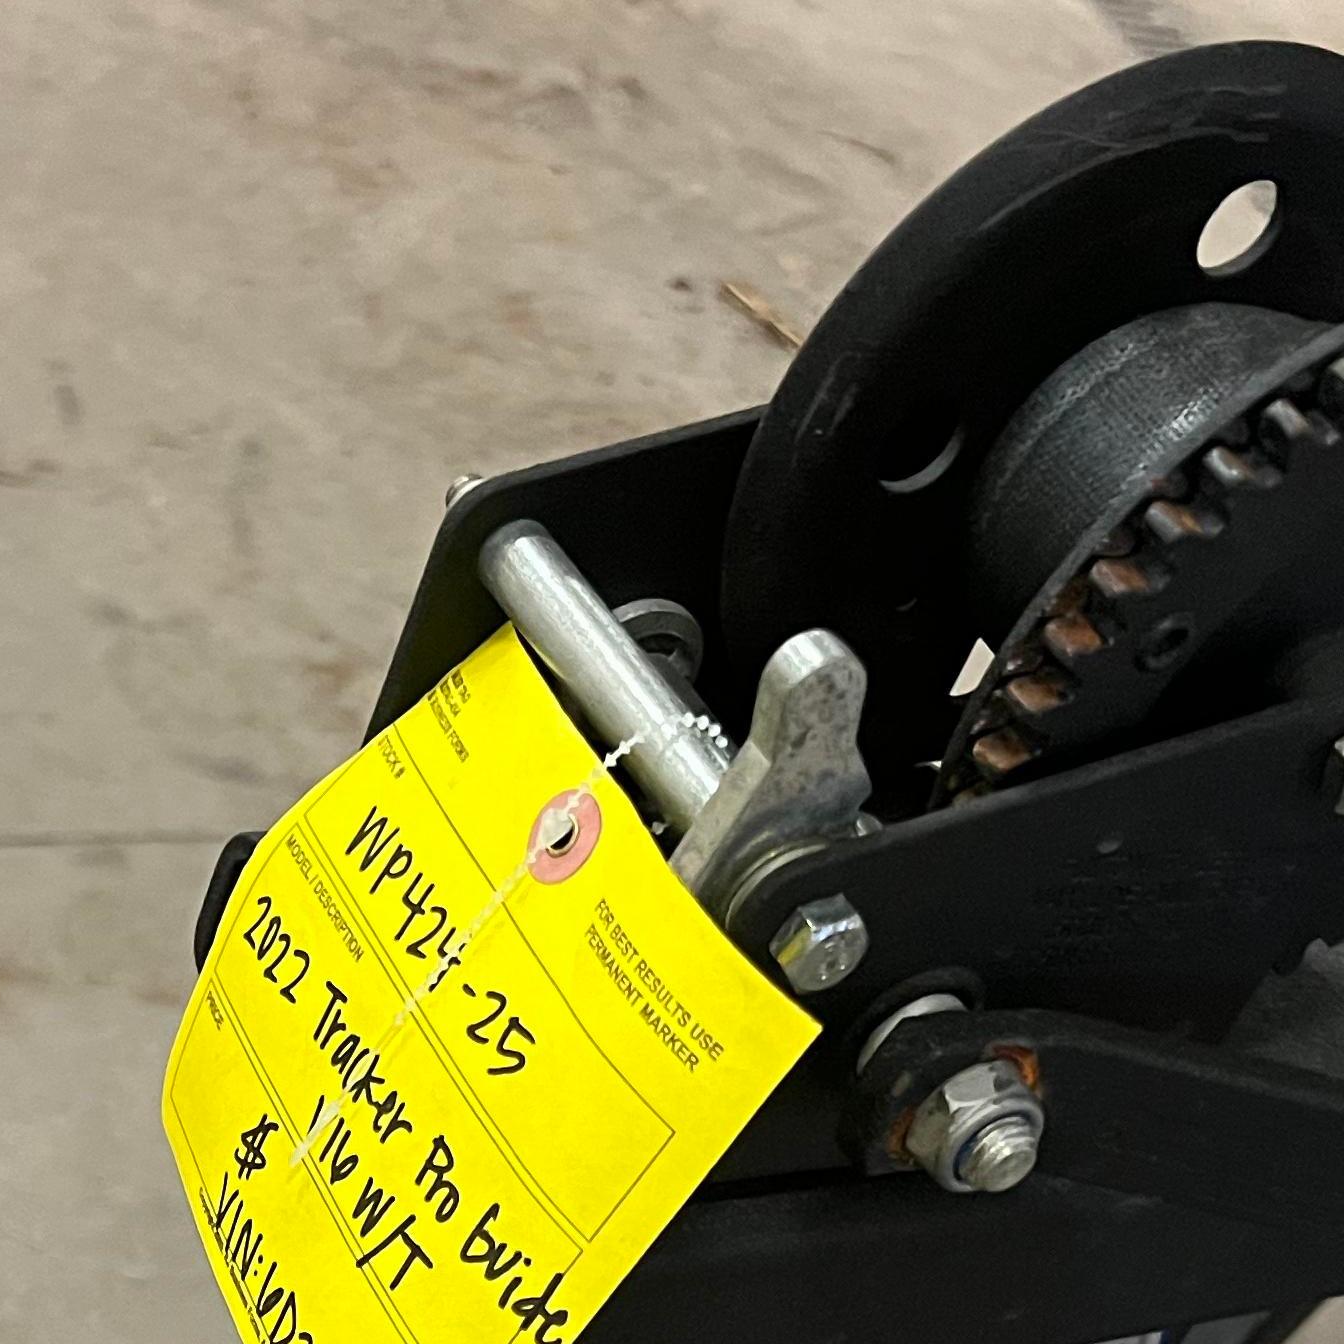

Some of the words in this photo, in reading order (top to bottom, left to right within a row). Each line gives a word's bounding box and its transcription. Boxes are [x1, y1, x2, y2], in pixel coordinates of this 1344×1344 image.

[285, 834, 313, 885] MODEL
[313, 880, 365, 963] DESCRIPTION
[584, 923, 644, 1007] PERMANENT
[639, 1003, 699, 1073] MARKER
[594, 898, 615, 931] FOR
[610, 924, 640, 963] BEST
[634, 959, 692, 1028] RESULTS
[690, 1023, 724, 1062] USE
[243, 895, 310, 1004] 2022
[313, 980, 413, 1144] Tracker
[414, 1134, 460, 1223] Pro
[234, 1113, 280, 1180] $
[352, 1176, 433, 1291] W/T
